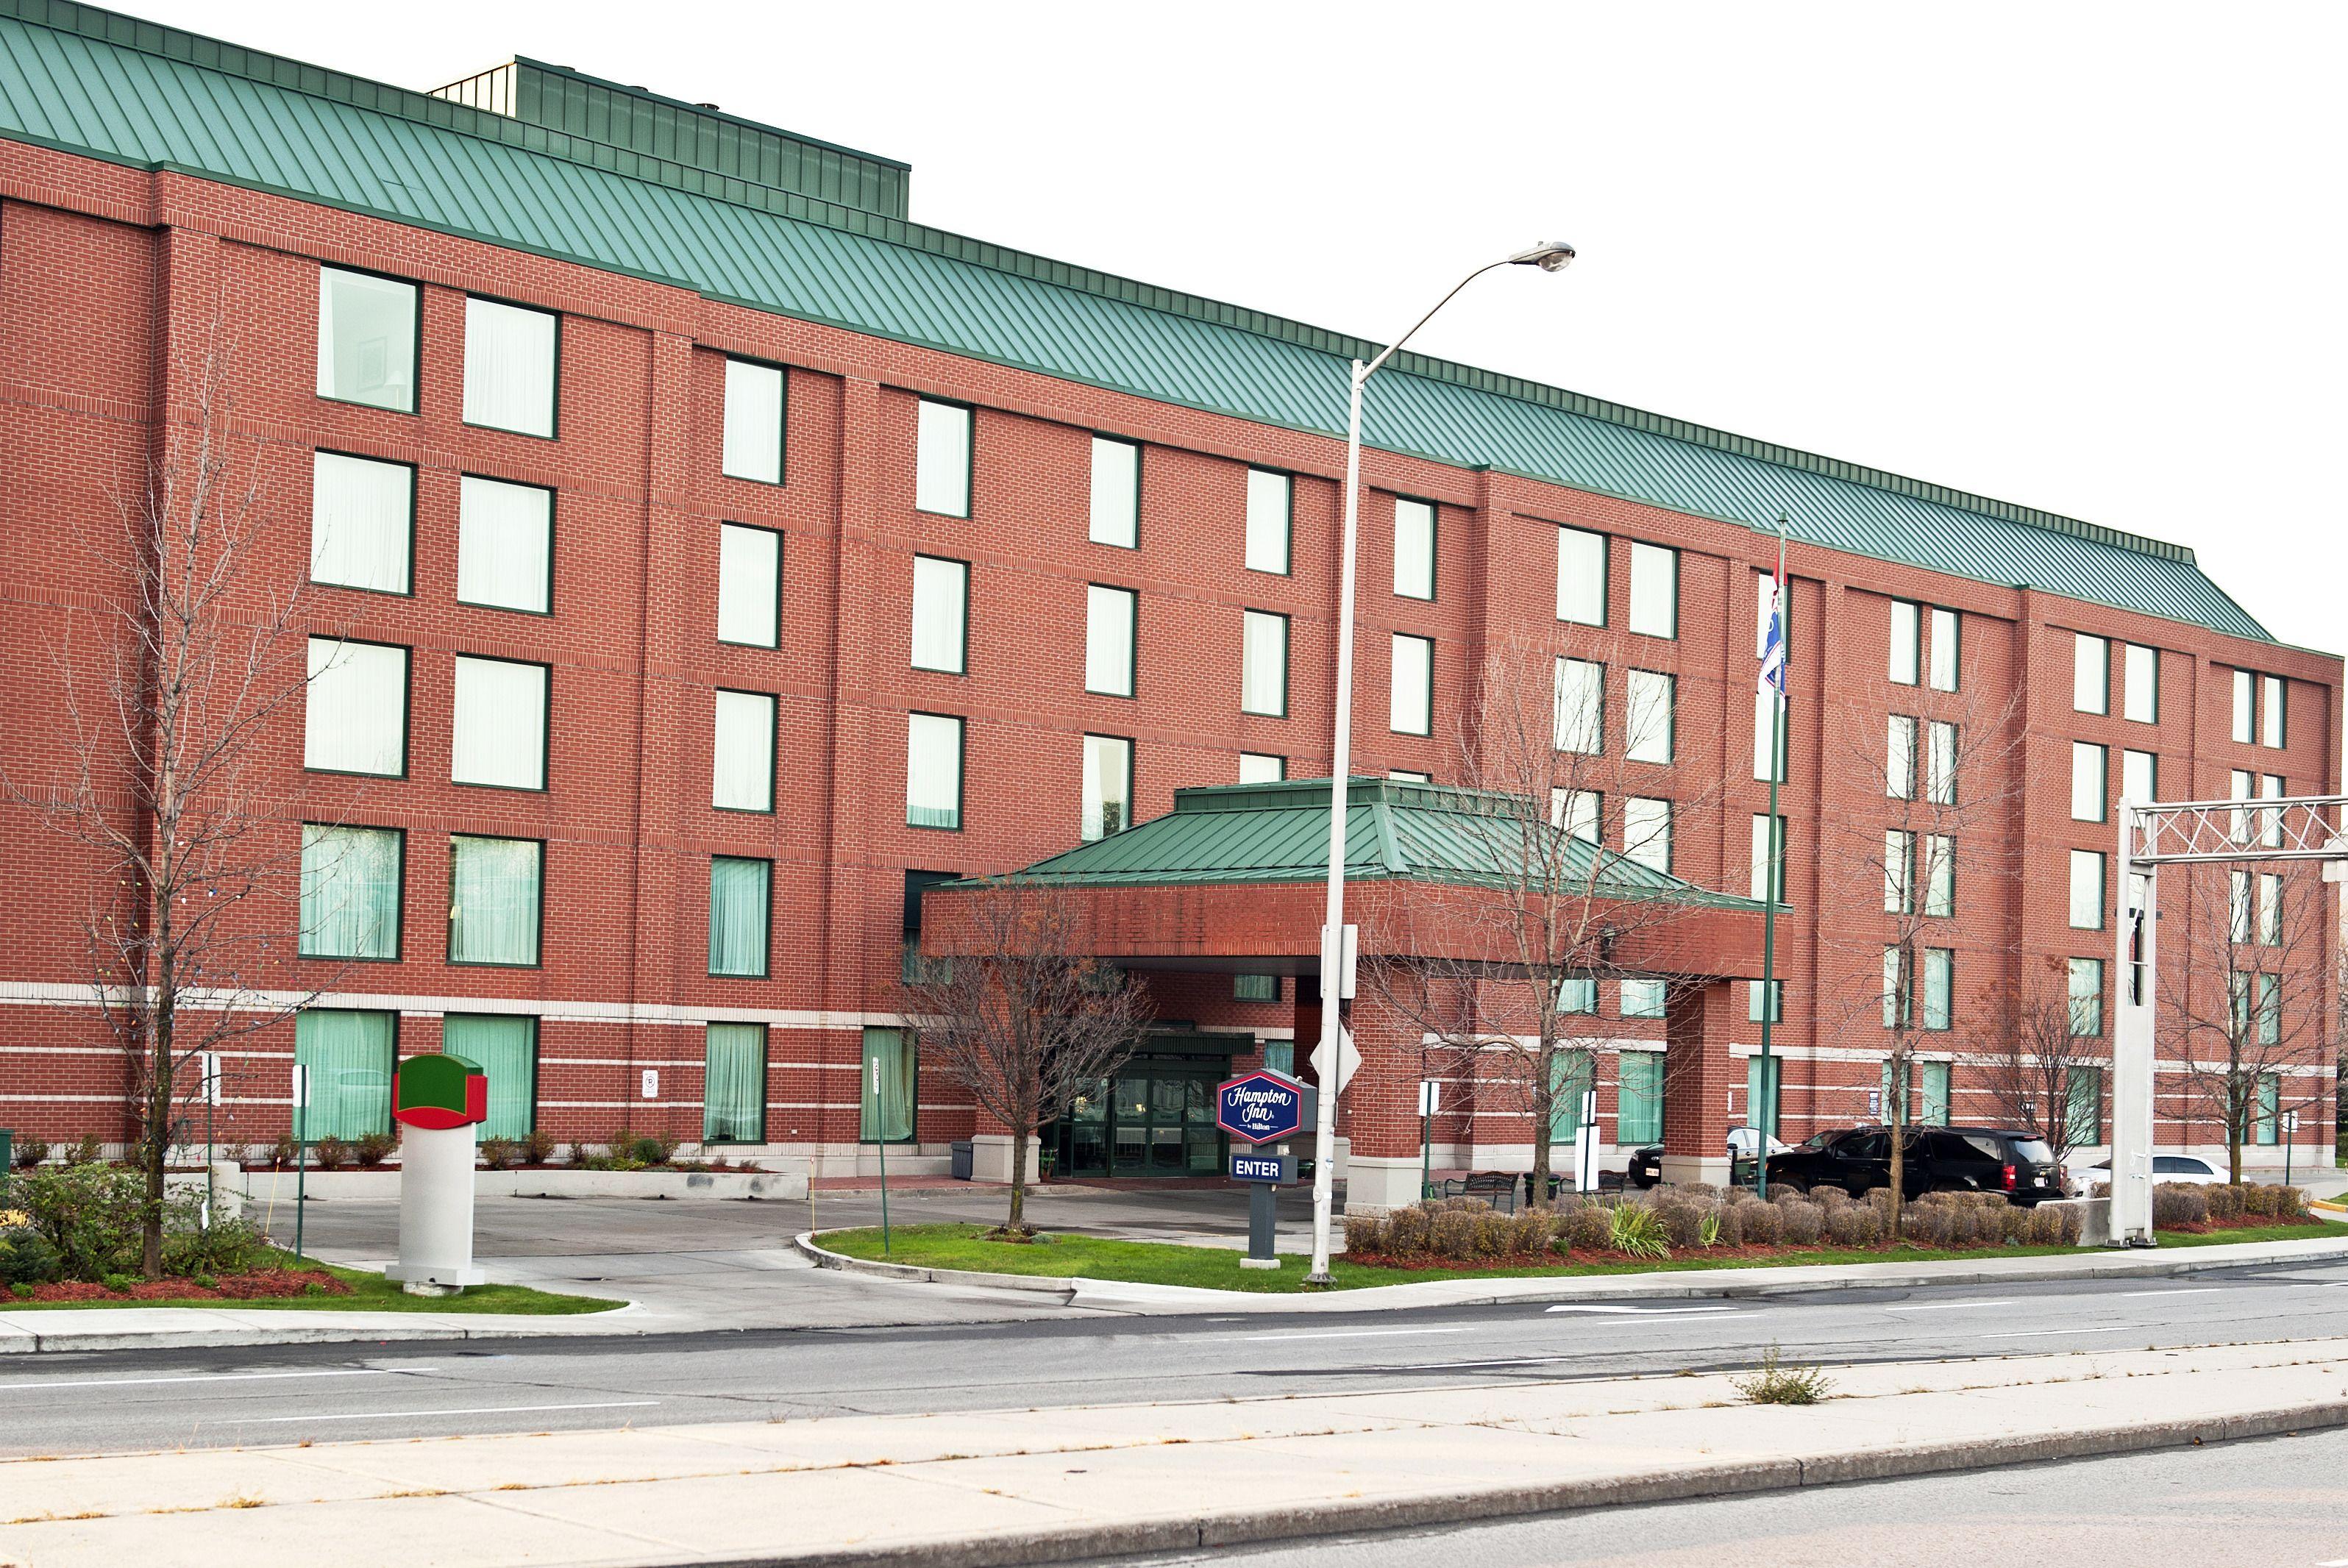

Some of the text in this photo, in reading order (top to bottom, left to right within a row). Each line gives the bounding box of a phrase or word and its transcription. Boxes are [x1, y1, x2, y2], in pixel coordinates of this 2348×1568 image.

[1228, 1086, 1292, 1107] Hampton
[1242, 1102, 1273, 1122] Inn
[1252, 1122, 1270, 1130] Hilton
[1236, 1160, 1279, 1177] ENTER
